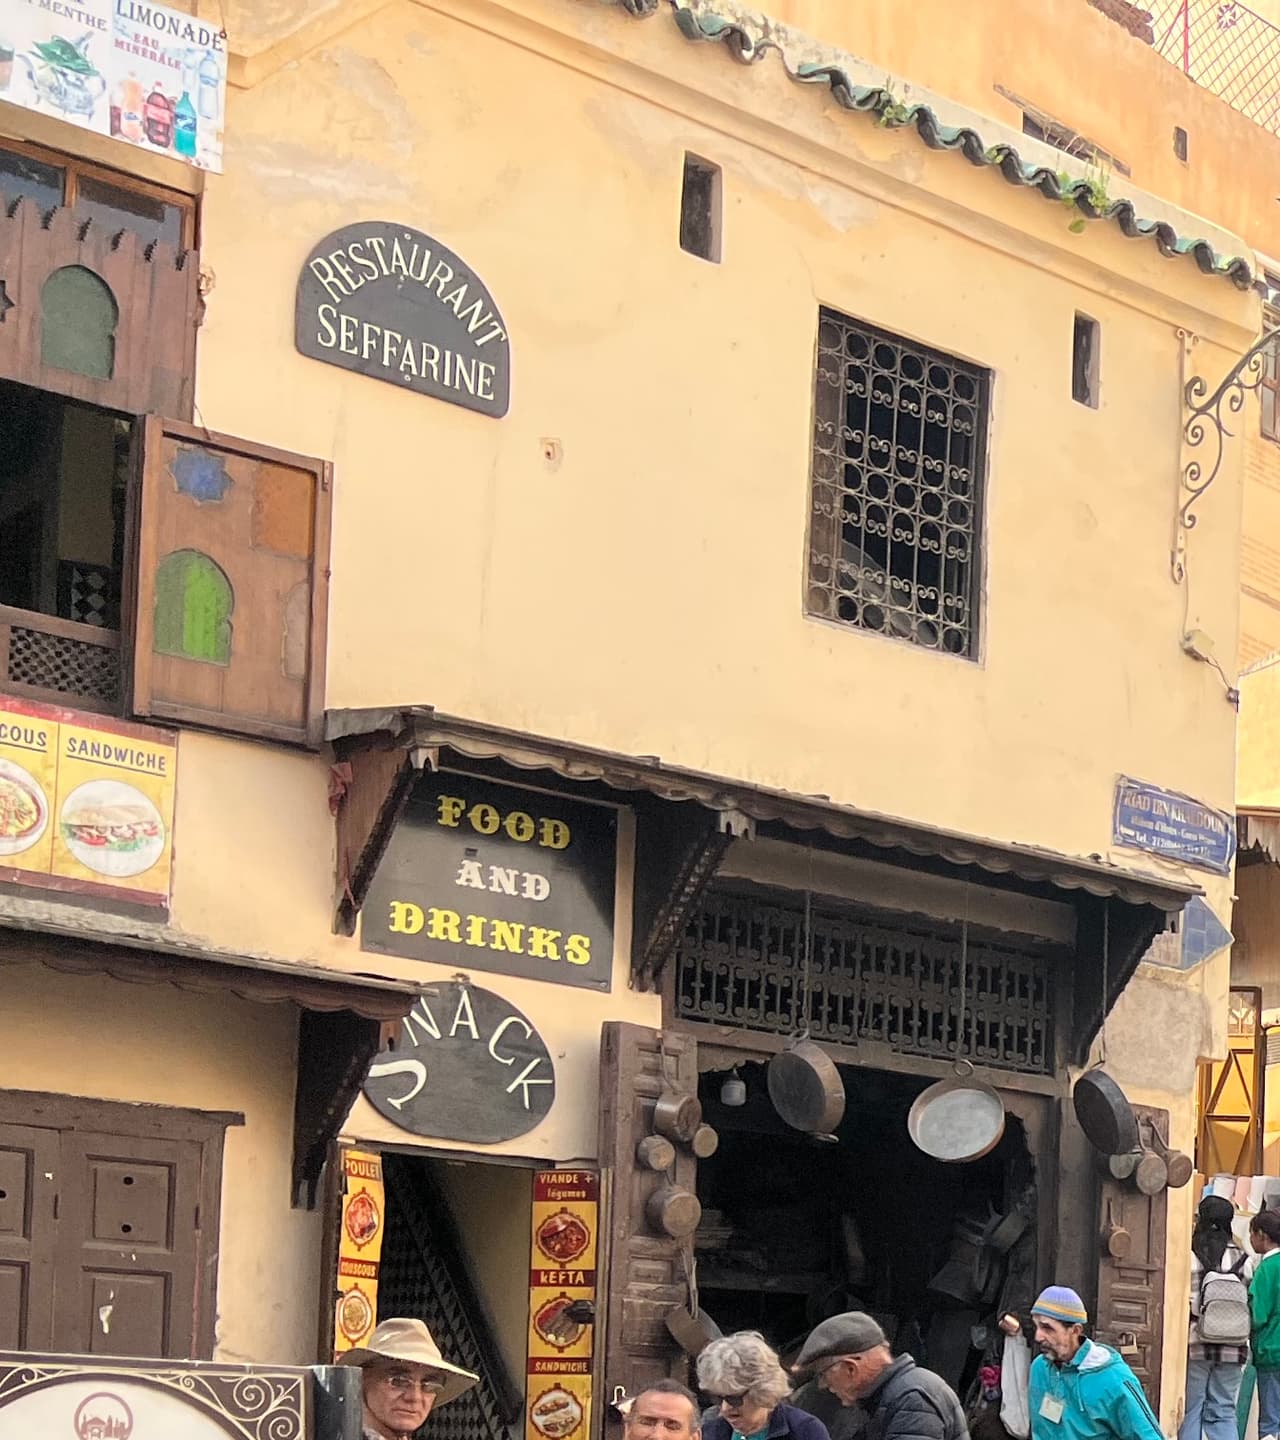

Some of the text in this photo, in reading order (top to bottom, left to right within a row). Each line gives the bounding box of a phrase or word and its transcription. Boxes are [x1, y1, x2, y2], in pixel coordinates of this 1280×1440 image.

[39, 0, 107, 31] MENTHE
[116, 0, 224, 52] LIMONADE
[133, 33, 159, 49] EAU
[309, 236, 508, 347] RESTAURANT
[316, 303, 497, 401] SEFFARINE
[66, 736, 167, 772] SANDWICHE
[436, 794, 571, 849] FOOD
[455, 859, 551, 901] AND
[388, 900, 592, 965] DRINKS
[539, 1173, 579, 1184] VIANDE
[534, 1361, 589, 1373] SANDWICHE
